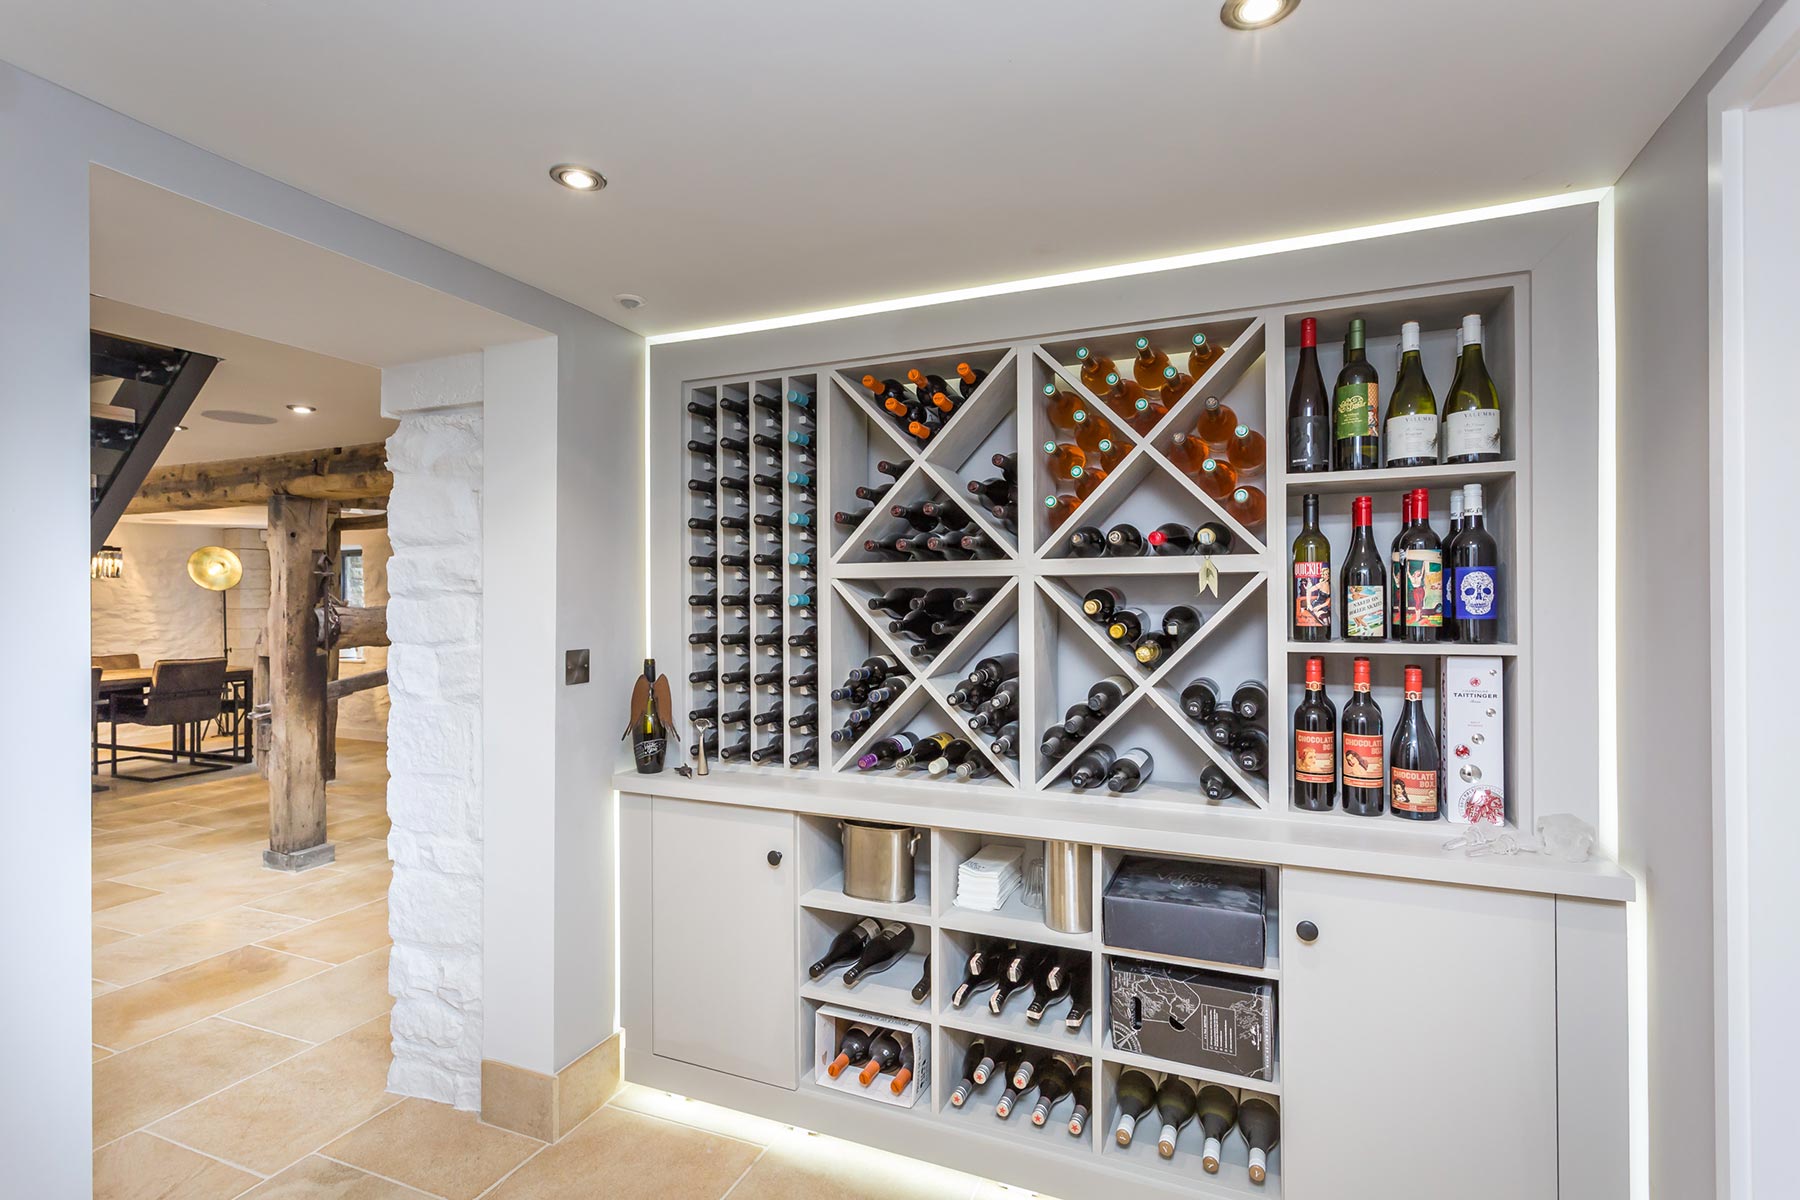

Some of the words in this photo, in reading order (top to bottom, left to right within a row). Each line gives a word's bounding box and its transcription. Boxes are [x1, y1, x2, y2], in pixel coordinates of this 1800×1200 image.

[1294, 562, 1322, 576] QUICKIE!
[1298, 735, 1334, 745] CHOCOLATE
[1345, 738, 1382, 748] CHOCOLATE
[1322, 743, 1333, 751] BOX
[1371, 747, 1382, 755] BOX
[1393, 771, 1434, 781] CHOCOLATE
[1419, 780, 1435, 788] BOX
